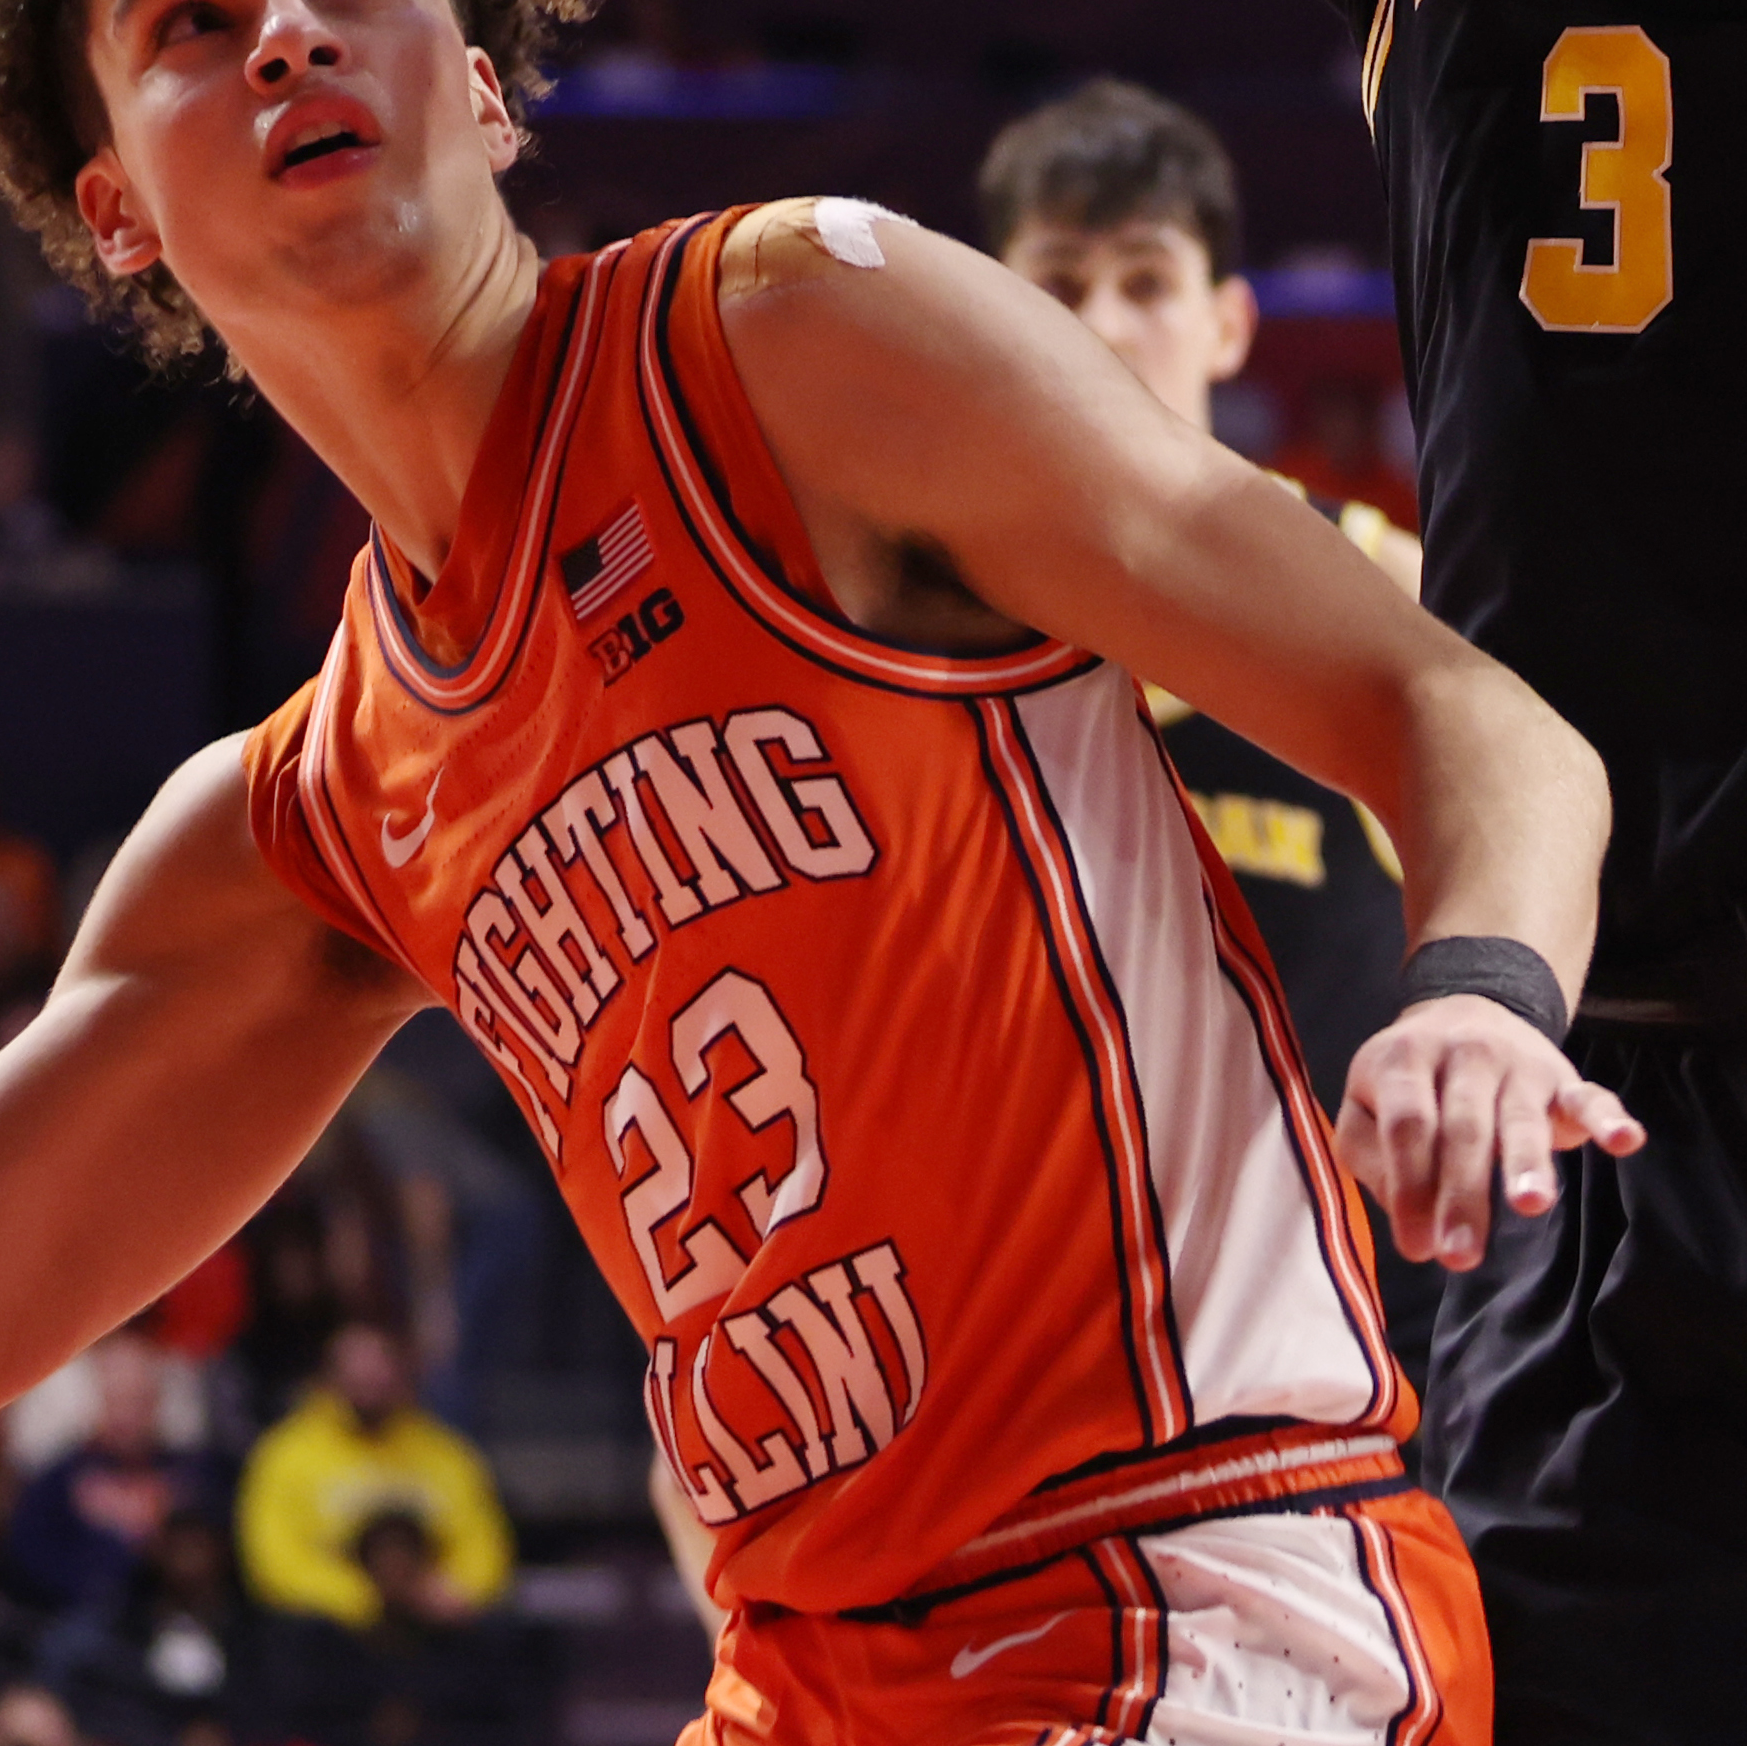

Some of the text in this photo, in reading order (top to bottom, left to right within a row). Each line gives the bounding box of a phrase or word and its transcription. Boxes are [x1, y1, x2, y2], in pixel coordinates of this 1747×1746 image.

[1518, 25, 1674, 334] 3
[452, 705, 876, 1168] FIGHTING
[603, 965, 829, 1325] 23
[644, 1239, 929, 1526] LLINI
